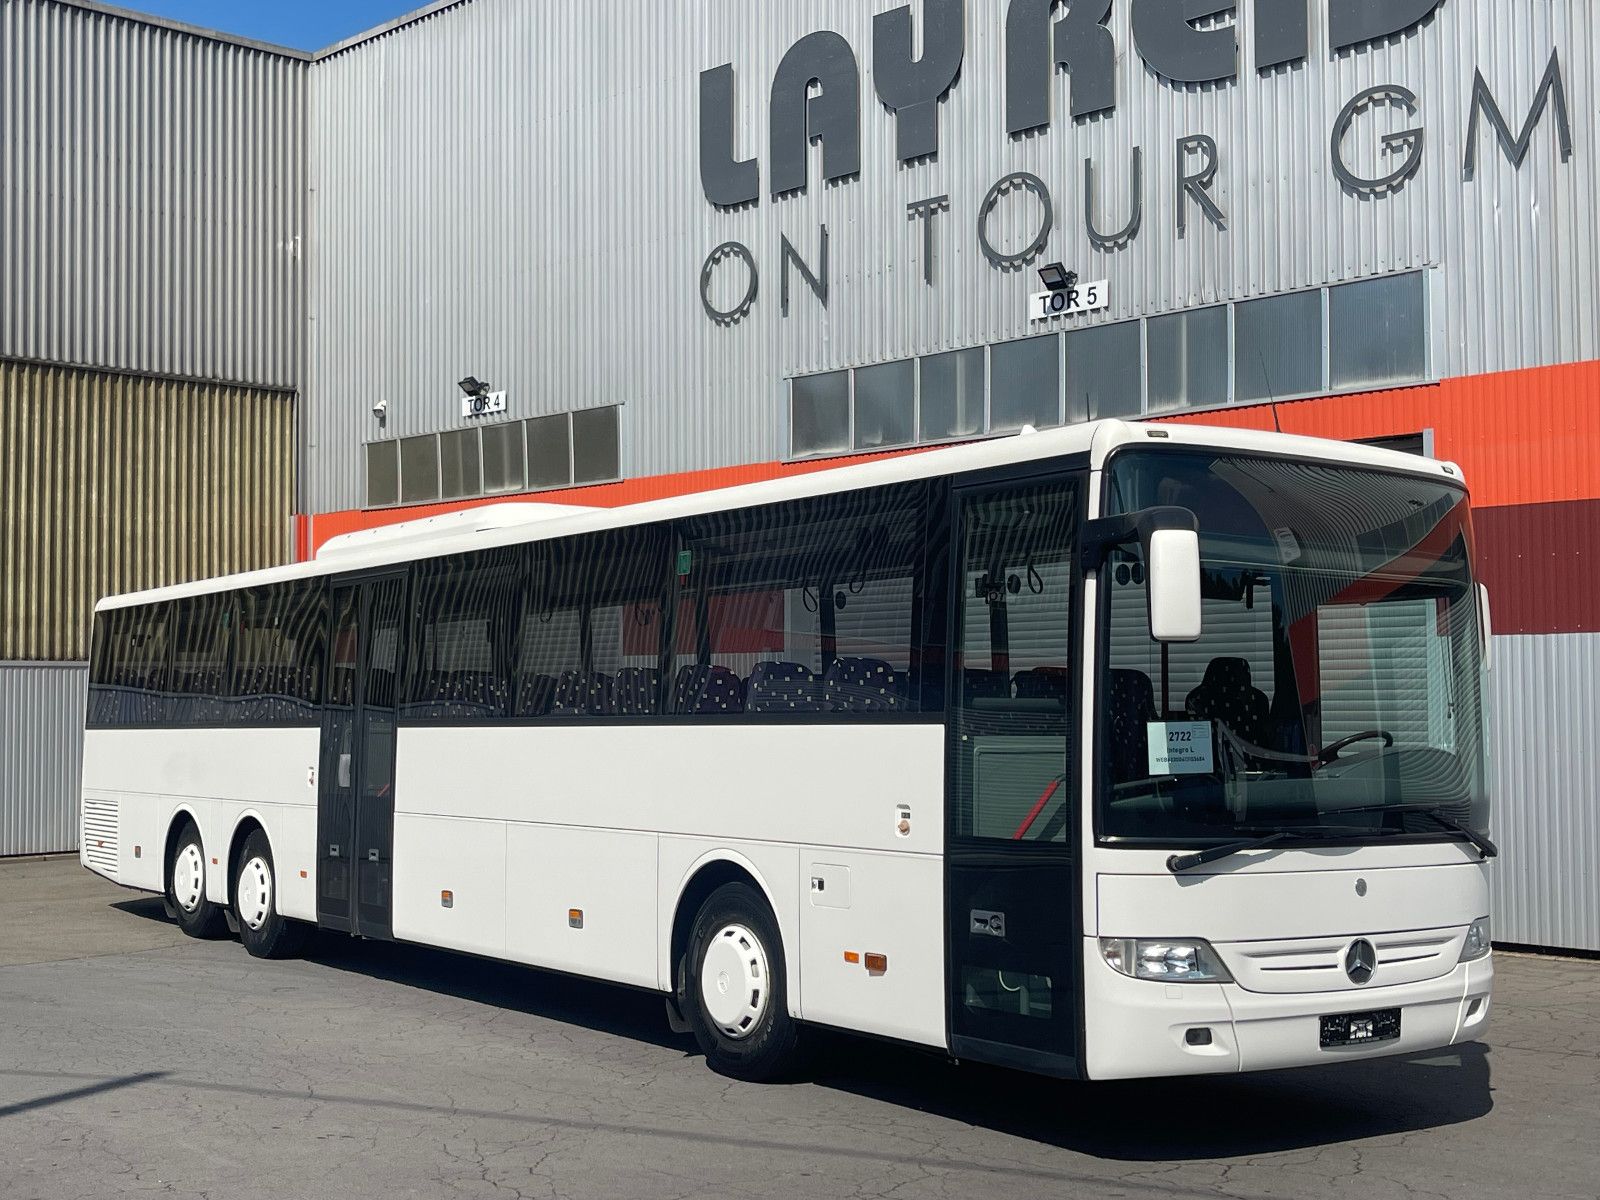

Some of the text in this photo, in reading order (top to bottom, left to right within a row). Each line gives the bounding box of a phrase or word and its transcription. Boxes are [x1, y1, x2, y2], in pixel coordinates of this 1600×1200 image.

[700, 46, 1572, 319] ON TOUR GM
[1038, 286, 1097, 315] TOR 5
[468, 394, 500, 412] TOR 4
[1168, 731, 1191, 741] 2722
